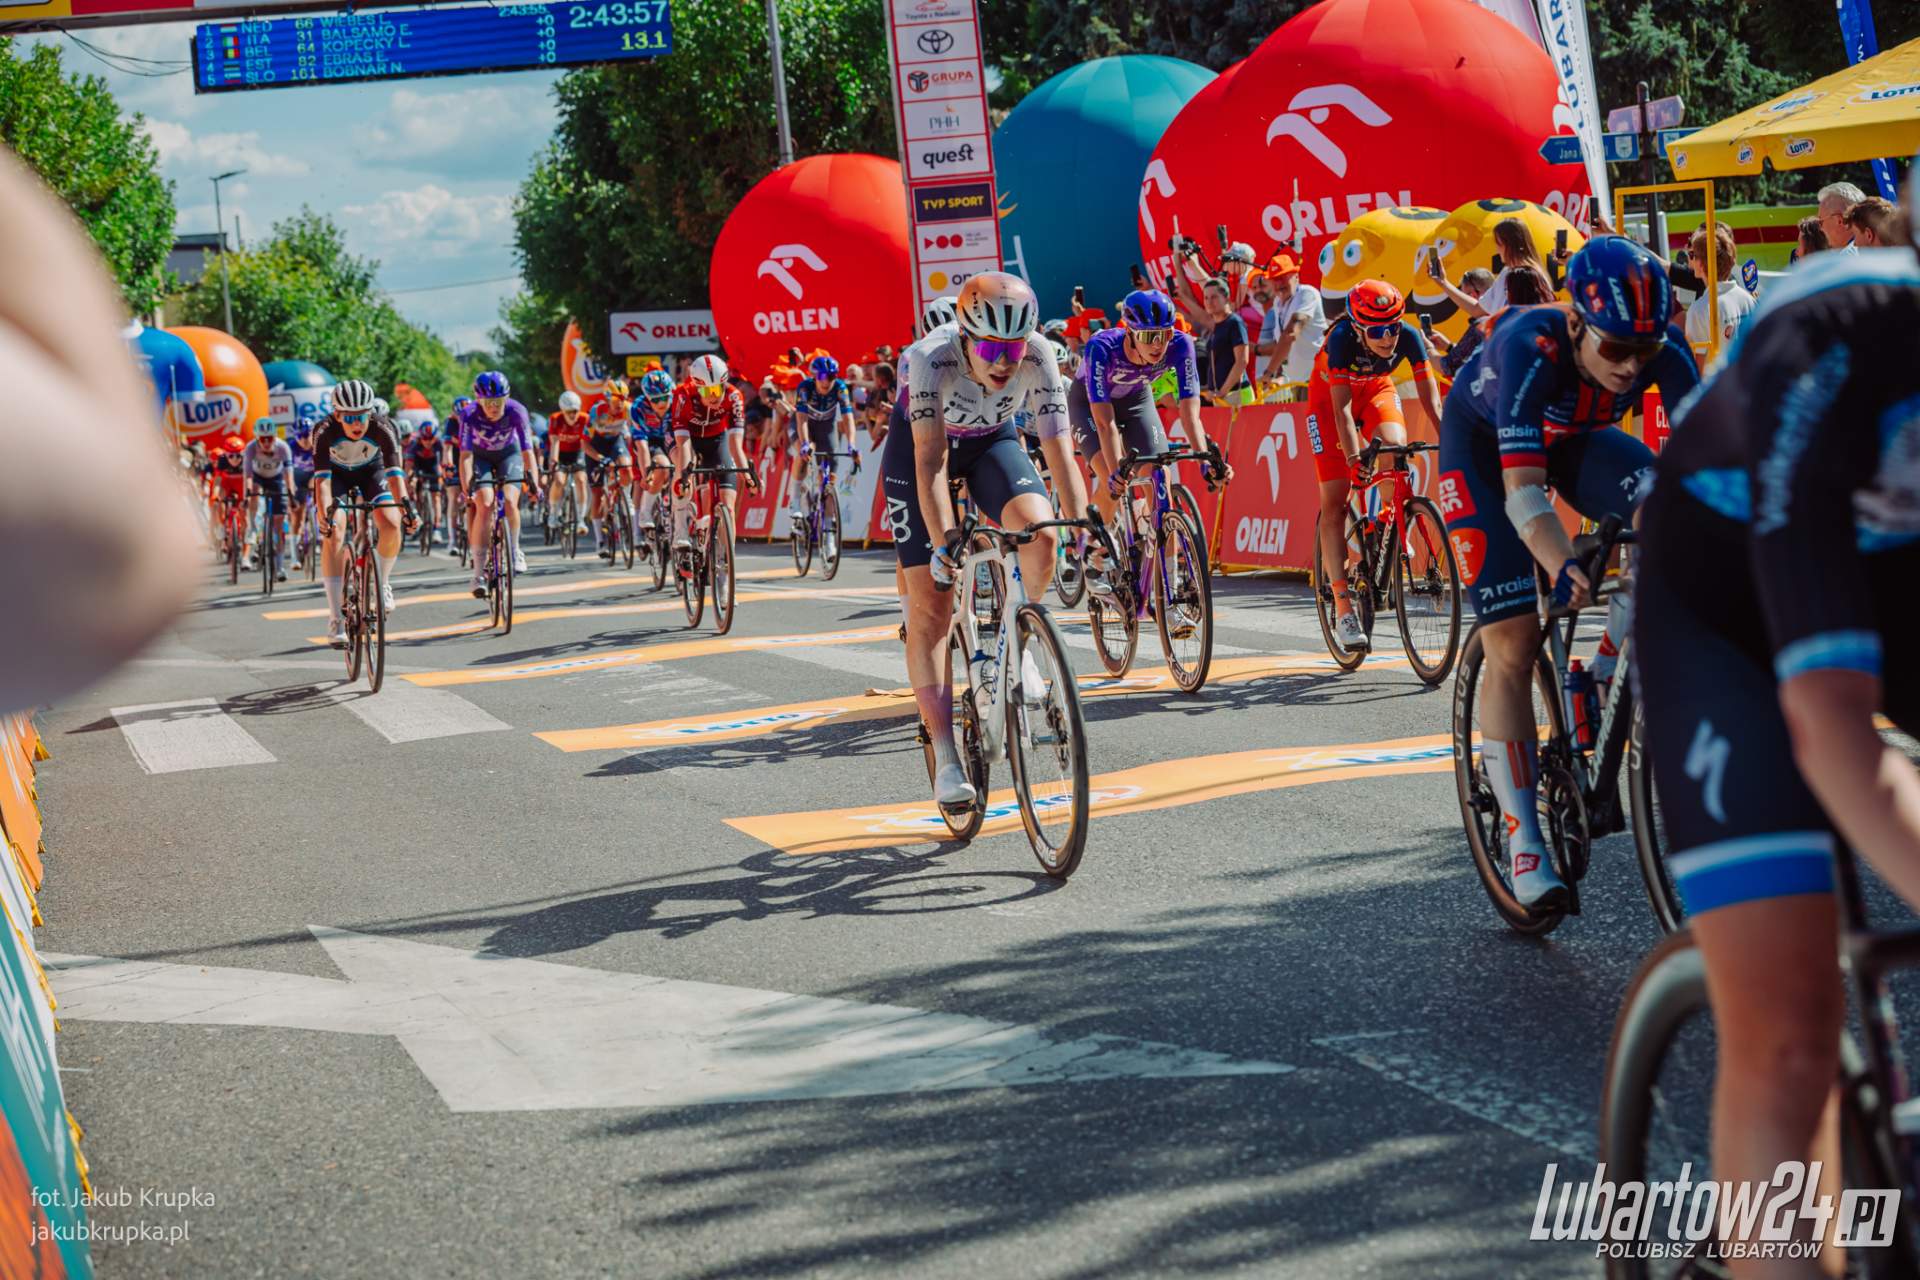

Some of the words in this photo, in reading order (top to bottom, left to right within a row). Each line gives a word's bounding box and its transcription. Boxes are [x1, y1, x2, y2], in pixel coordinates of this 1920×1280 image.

[241, 22, 273, 33] NED
[320, 14, 375, 27] WIEBES
[321, 26, 397, 40] BALSAMO
[536, 14, 555, 27] +0
[569, 1, 668, 29] 2:43:57
[245, 46, 273, 57] BEL
[322, 36, 394, 52] KOPECKY
[536, 26, 556, 39] +0
[621, 31, 667, 50] 13.1
[245, 58, 273, 69] EST
[323, 51, 373, 66] EBRAS
[538, 39, 557, 51] +0
[245, 71, 276, 83] SLO
[538, 51, 557, 63] +0
[931, 71, 974, 82] GRUPA
[922, 143, 974, 169] quest
[922, 198, 946, 210] TVP
[948, 195, 984, 209] SPORT
[1608, 277, 1630, 322] LAZER
[652, 323, 711, 339] ORLEN
[753, 307, 839, 334] ORLEN
[1093, 360, 1105, 398] Jayco
[1184, 358, 1193, 394] Jayco
[183, 398, 232, 424] LOTTO
[1497, 424, 1540, 440] raisin
[1235, 516, 1290, 555] ORLEN
[678, 711, 801, 734] LOTTO
